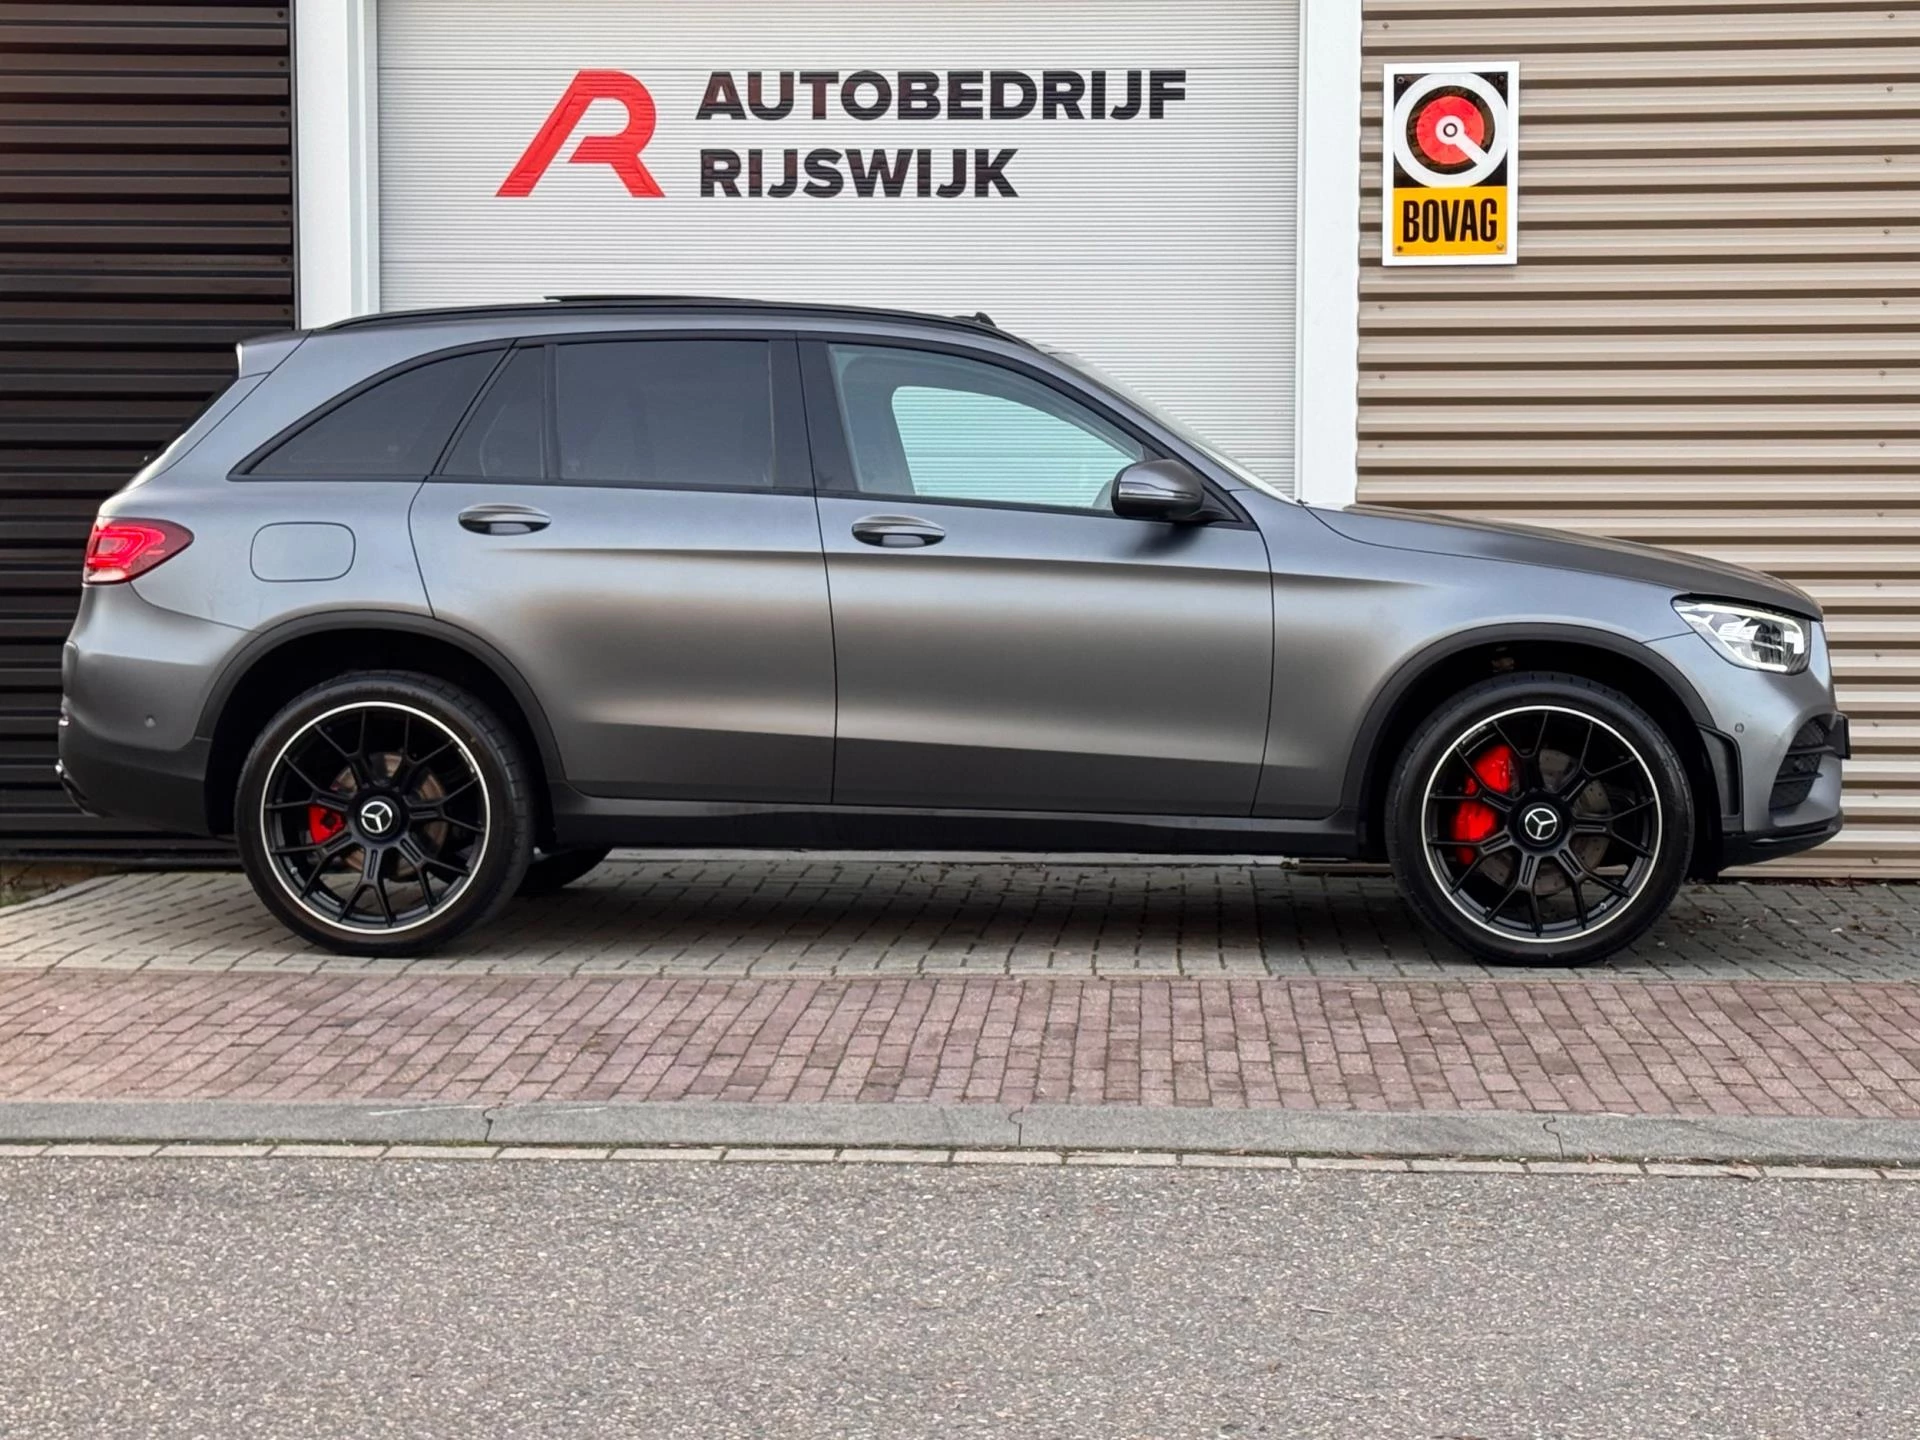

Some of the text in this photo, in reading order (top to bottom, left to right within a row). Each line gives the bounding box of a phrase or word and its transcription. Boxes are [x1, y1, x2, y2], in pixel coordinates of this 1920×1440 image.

[696, 70, 1187, 120] AUTOBEDRIJF
[700, 149, 1018, 198] RIJSWIJK
[1402, 198, 1498, 243] BOVAG
